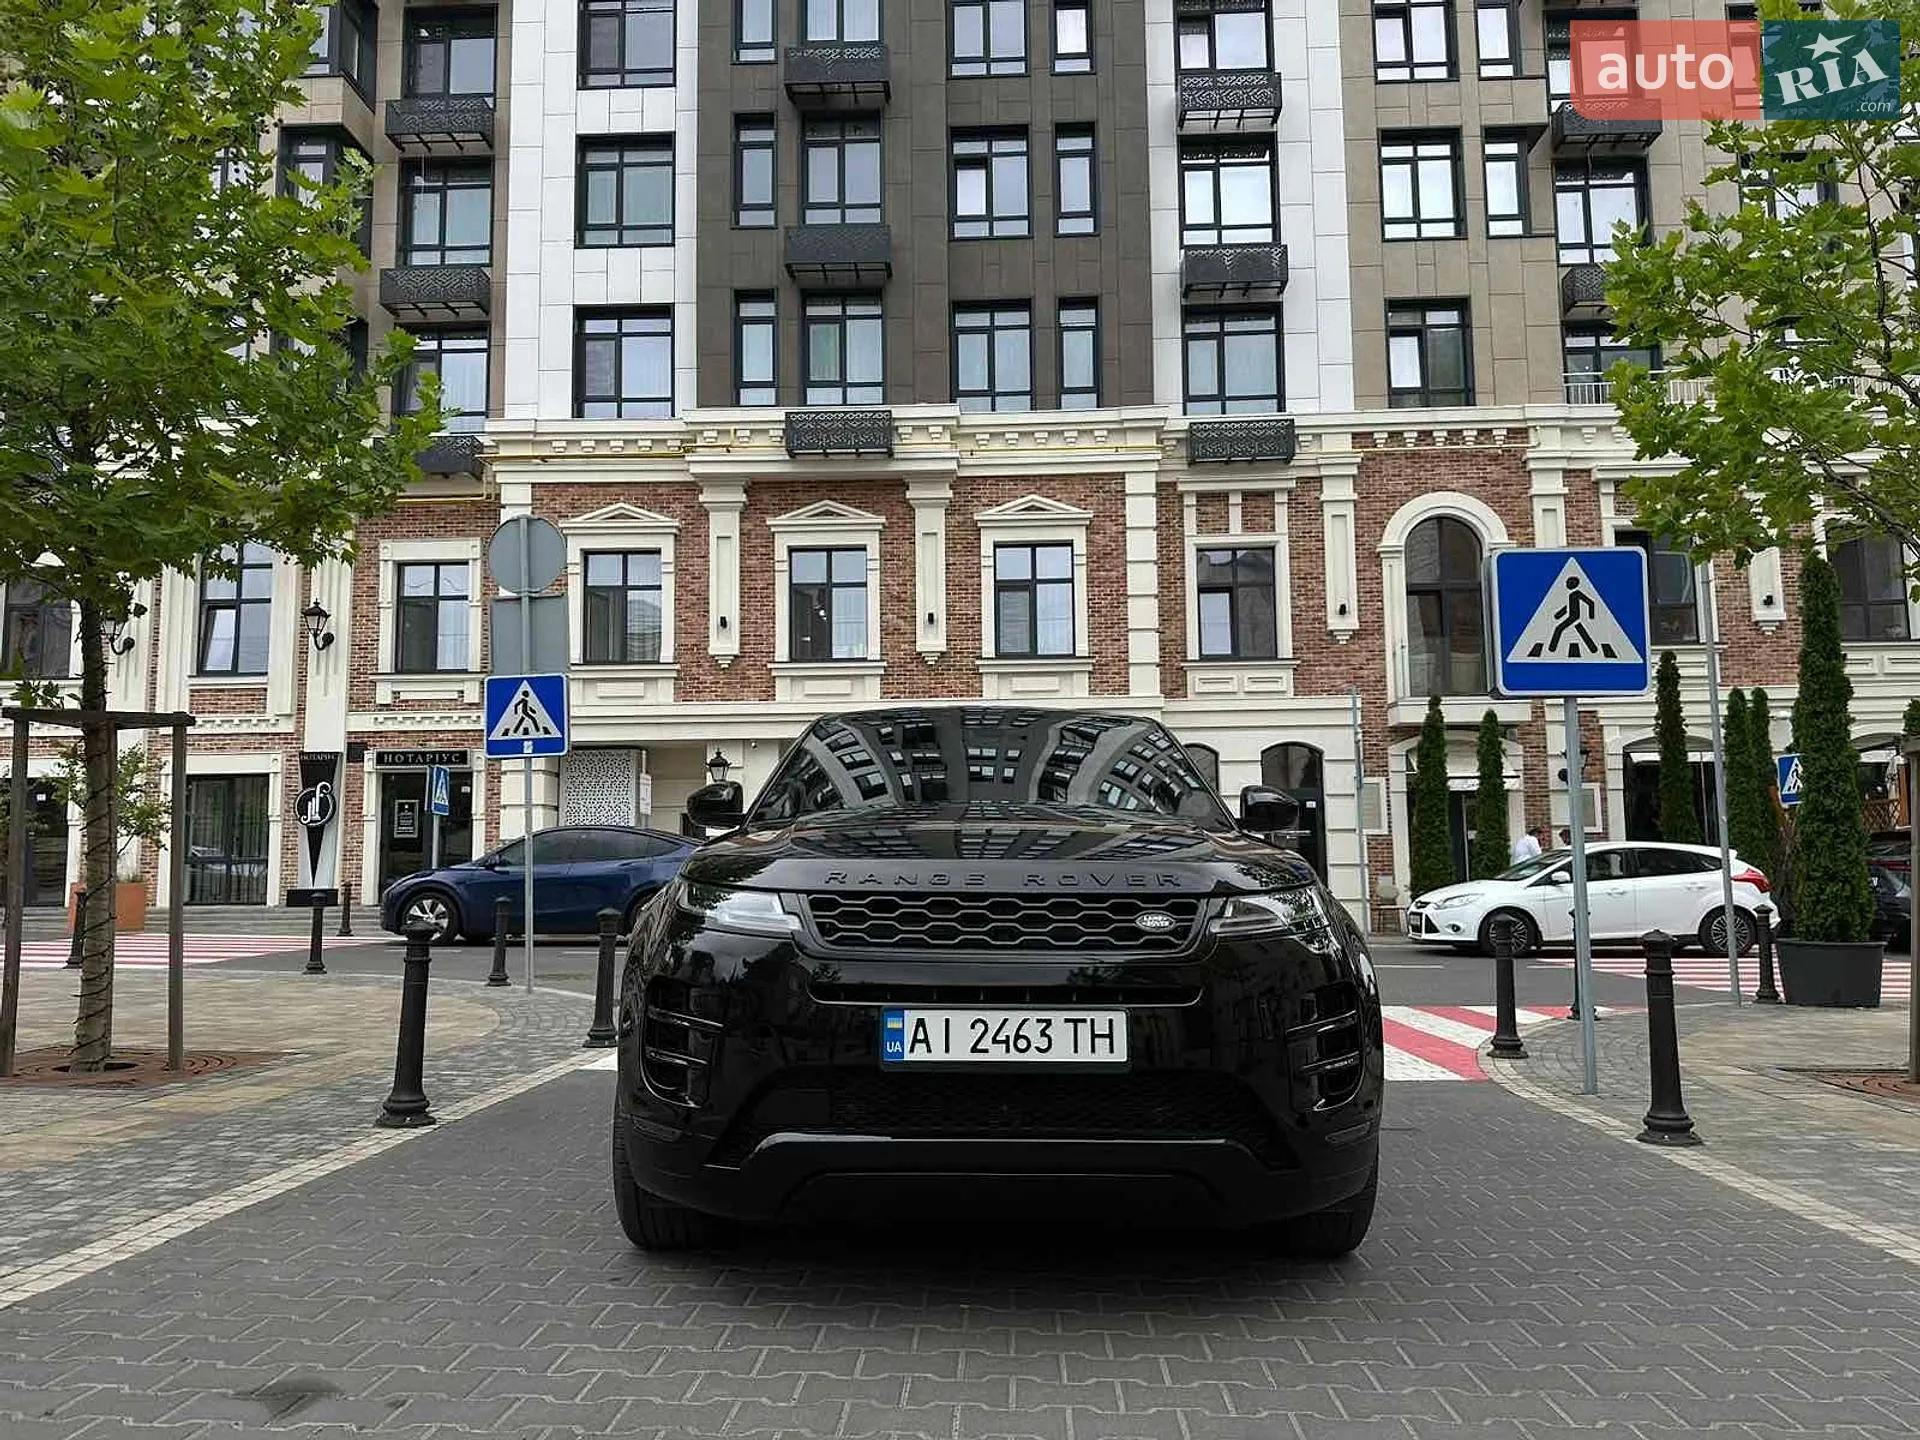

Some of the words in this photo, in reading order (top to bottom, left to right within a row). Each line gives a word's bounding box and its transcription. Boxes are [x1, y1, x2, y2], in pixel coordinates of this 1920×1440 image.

[383, 753, 460, 763] НОТАРІУС
[825, 872, 986, 886] RANGE
[1023, 872, 1182, 887] ROVER
[969, 1017, 1053, 1054] 2463
[1063, 1017, 1115, 1054] TH
[886, 1041, 902, 1053] UA
